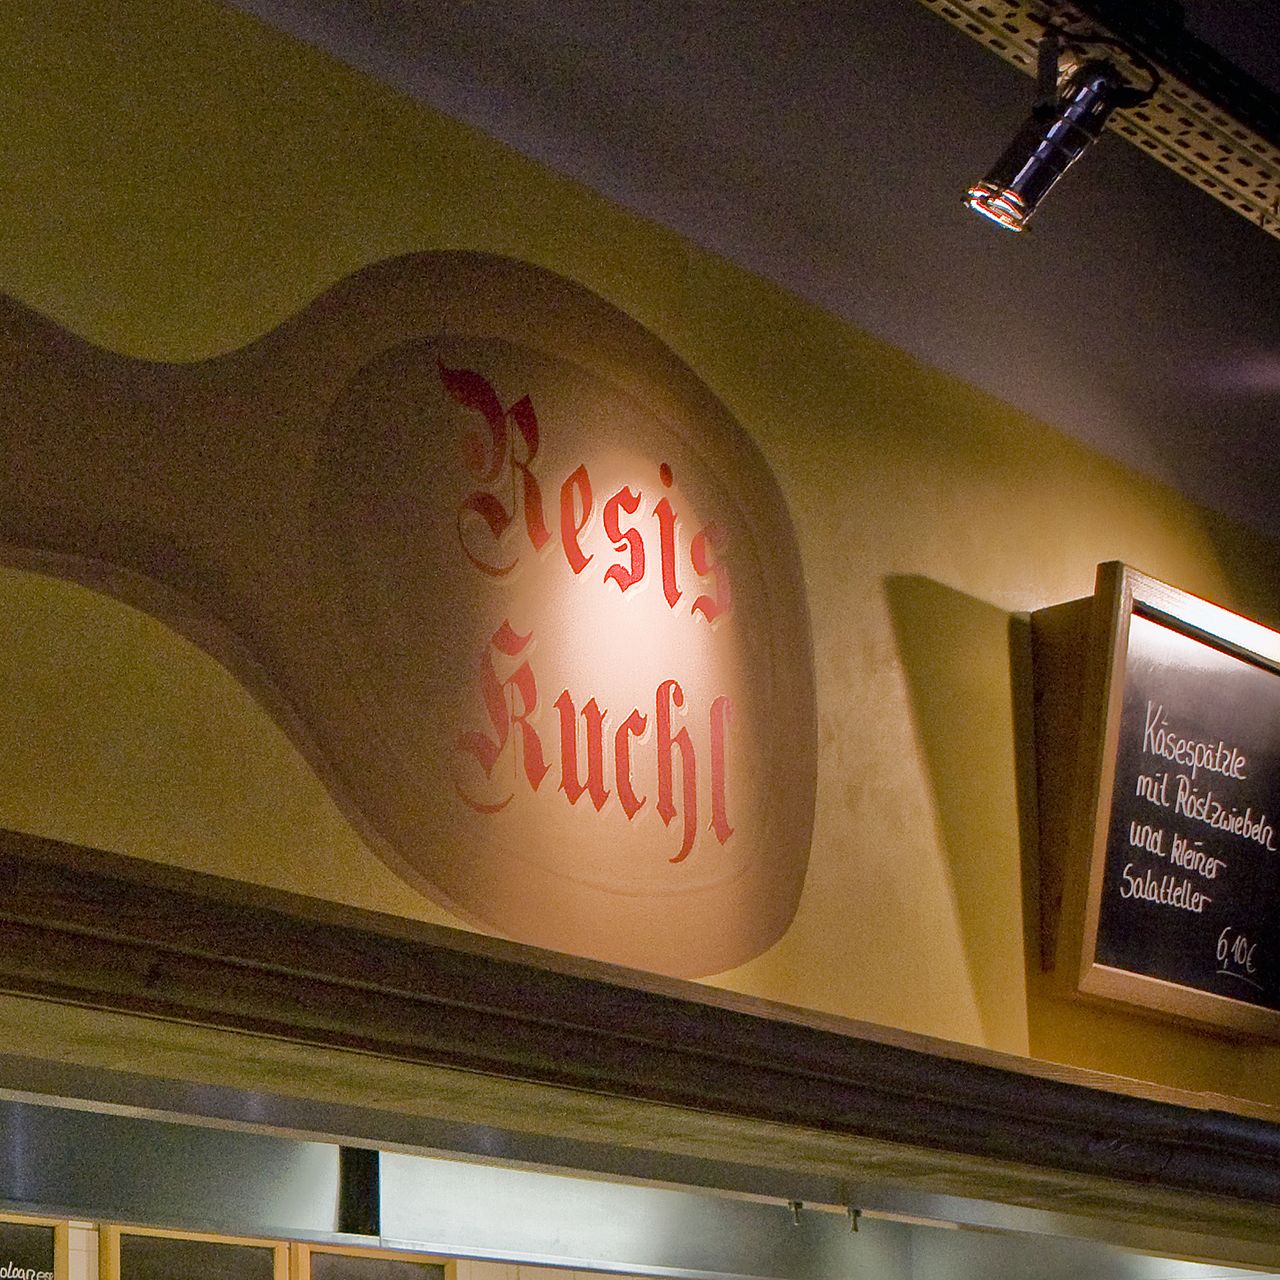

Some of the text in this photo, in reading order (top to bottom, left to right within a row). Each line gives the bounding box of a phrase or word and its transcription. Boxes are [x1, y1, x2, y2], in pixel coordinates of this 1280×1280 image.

[439, 365, 732, 624] Resis
[455, 618, 735, 864] Kuchl
[1129, 820, 1166, 857] und
[1136, 773, 1277, 852] mit Röstzwiebeln
[1120, 862, 1212, 913] Salatteller
